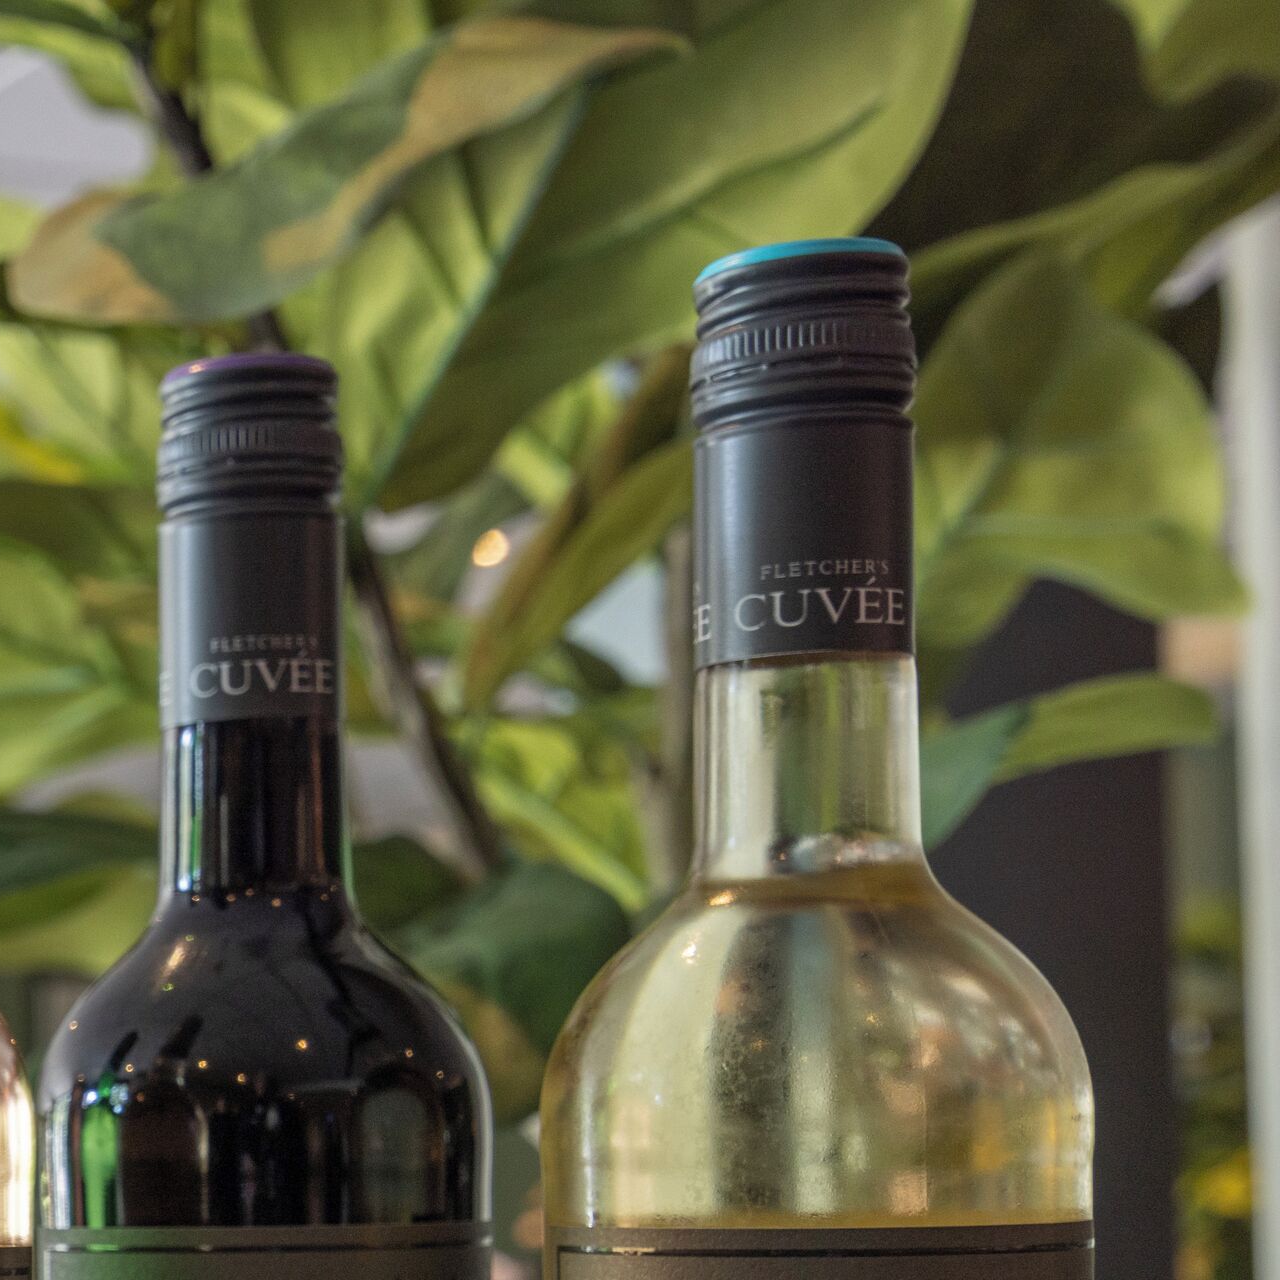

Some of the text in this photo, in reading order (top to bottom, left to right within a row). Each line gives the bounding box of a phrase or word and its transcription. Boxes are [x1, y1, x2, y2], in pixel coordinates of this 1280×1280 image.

[760, 558, 889, 580] FLETCHER'S
[734, 575, 905, 632] CUVÉE
[190, 650, 334, 699] CUVÉE
